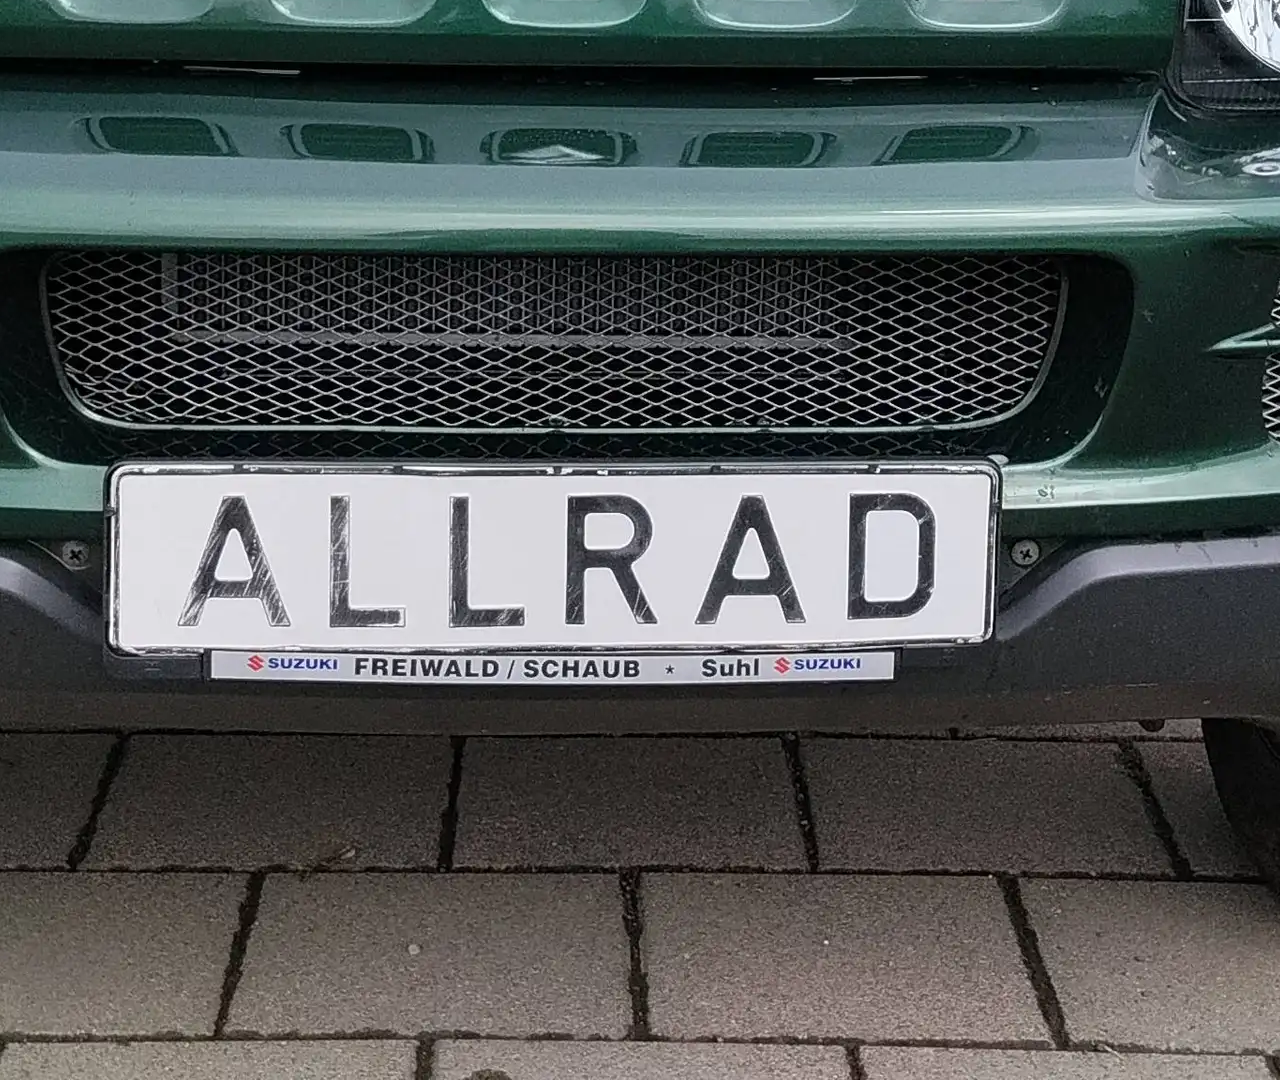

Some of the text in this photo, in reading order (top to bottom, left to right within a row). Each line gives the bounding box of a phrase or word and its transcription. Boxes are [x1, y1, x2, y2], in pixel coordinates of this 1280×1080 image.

[176, 492, 938, 628] ALLRAD
[268, 657, 338, 671] SUZUKI
[354, 658, 499, 678] FREIWALD
[523, 658, 641, 678] SCHAUB
[701, 658, 760, 678] Suhl
[794, 658, 862, 670] SUZUKI
